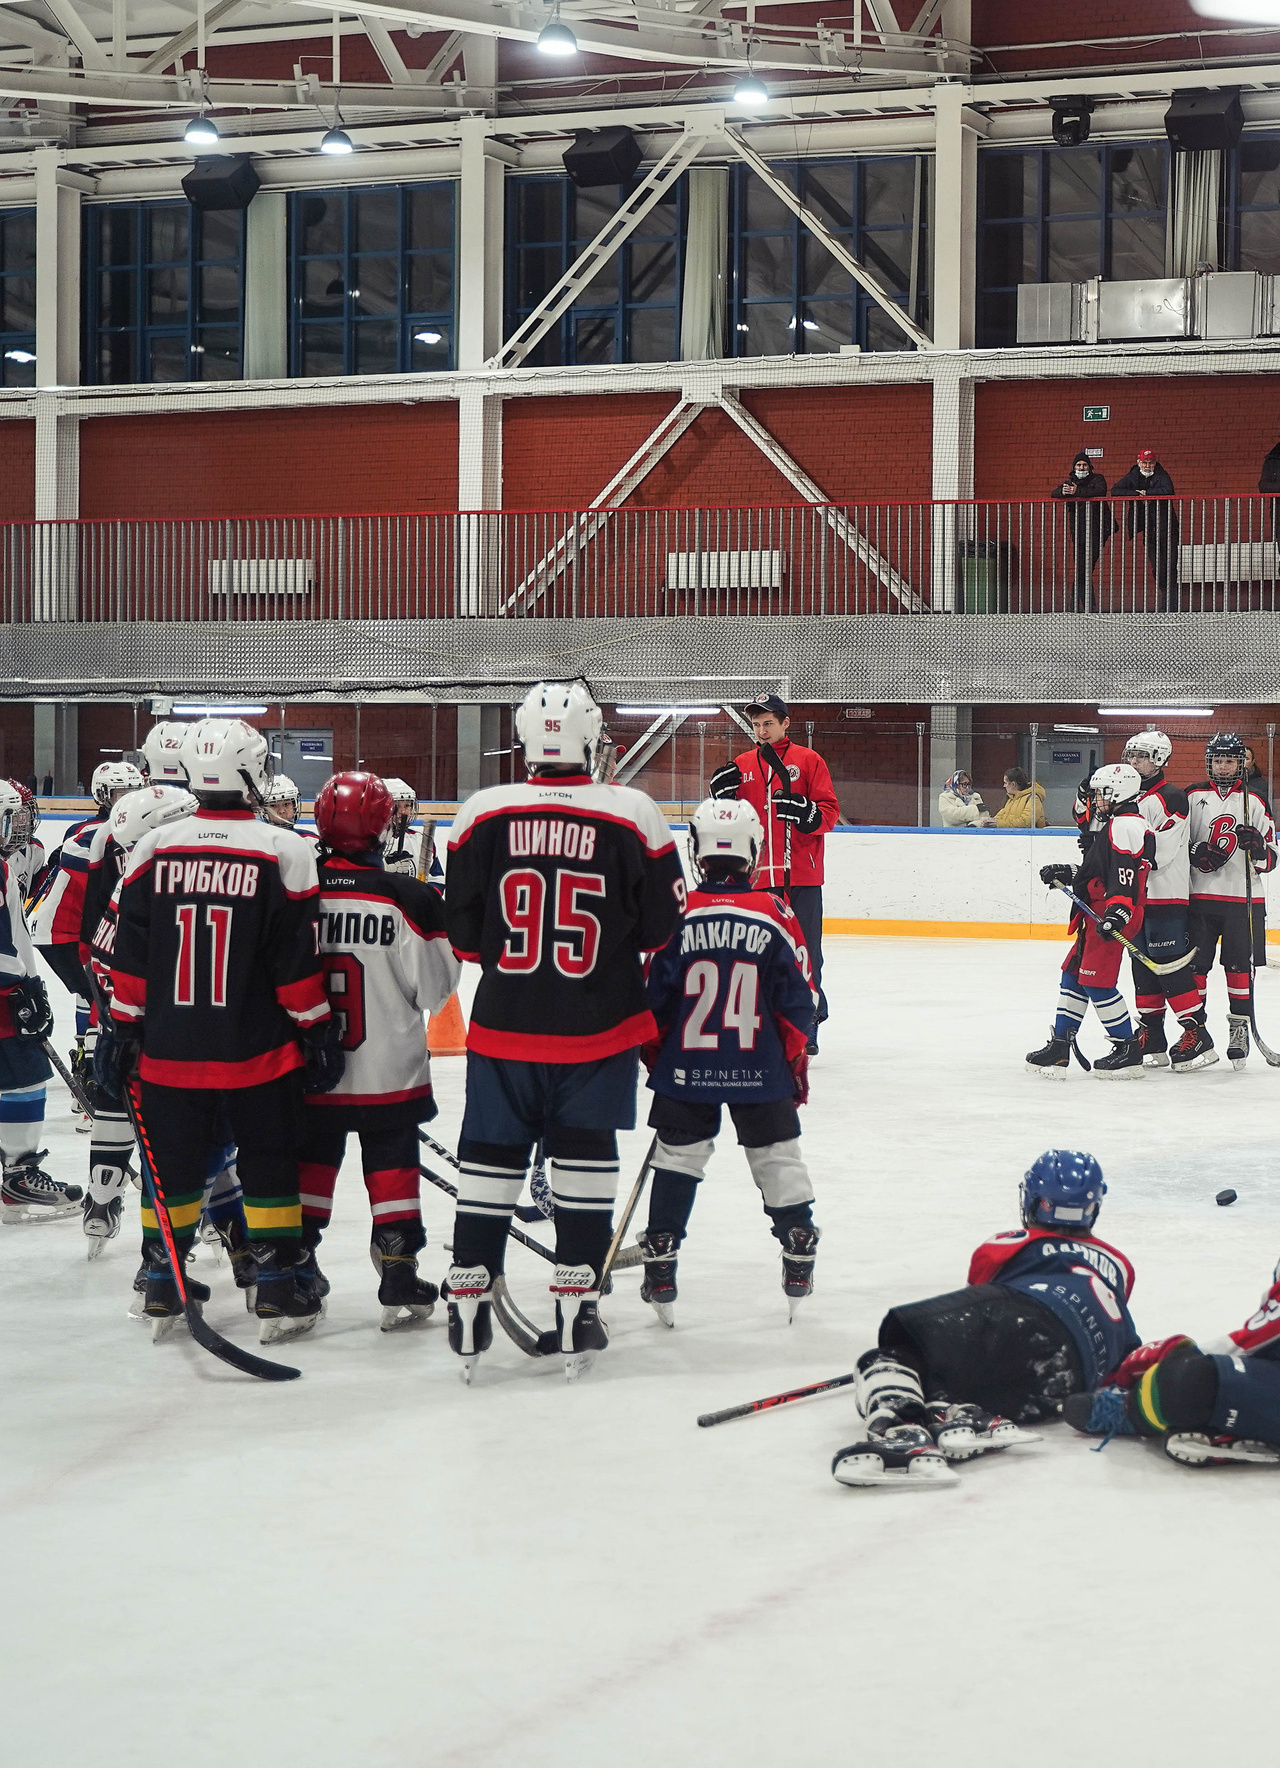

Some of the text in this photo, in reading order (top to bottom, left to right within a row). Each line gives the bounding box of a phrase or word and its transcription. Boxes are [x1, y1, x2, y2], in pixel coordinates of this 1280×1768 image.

[544, 719, 561, 732] 95
[164, 738, 179, 749] 22
[204, 742, 215, 754] 11
[539, 791, 572, 799] LUTCH
[116, 811, 127, 824] 25
[719, 810, 733, 820] 24
[198, 832, 228, 840] LUTCH
[509, 820, 597, 861] ШИНОВ
[155, 860, 260, 898] ГРИБКОВ
[326, 878, 356, 886] LUTCH
[497, 867, 606, 979] 95
[680, 921, 772, 955] МАКАРОВ
[1148, 940, 1176, 948] BAUER
[174, 903, 235, 1007] 11
[682, 959, 762, 1051] 24
[692, 1070, 763, 1079] SPINETIX
[556, 1270, 591, 1278] Ultra
